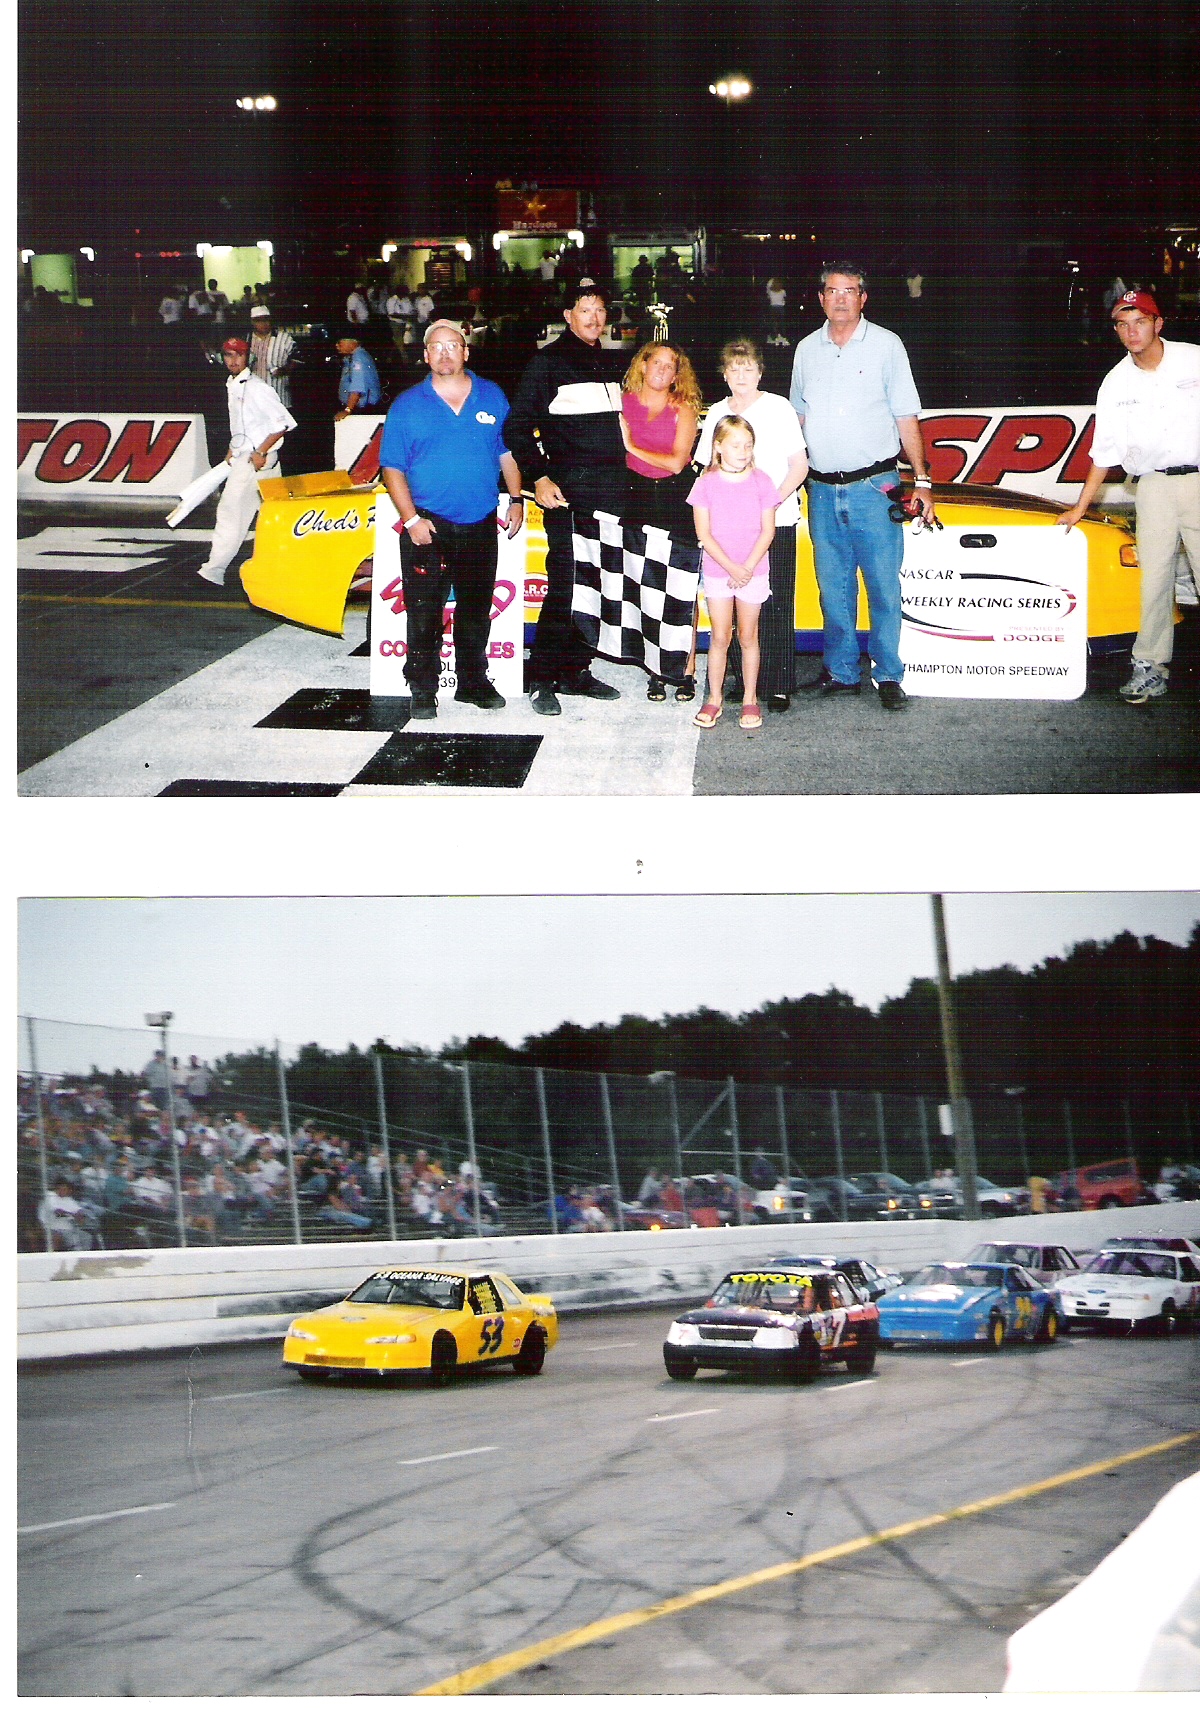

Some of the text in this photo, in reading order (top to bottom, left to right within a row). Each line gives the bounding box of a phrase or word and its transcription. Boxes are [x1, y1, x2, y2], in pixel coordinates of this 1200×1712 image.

[293, 508, 360, 537] Ched's
[900, 569, 954, 580] NASCAR
[901, 596, 1061, 609] WEEKLY RACING SERIES
[1003, 634, 1065, 642] DODGE
[966, 665, 1005, 675] MOTOR
[1008, 665, 1070, 676] SPEEDWAY
[730, 1274, 813, 1288] TOYOTA
[478, 1316, 505, 1356] 53
